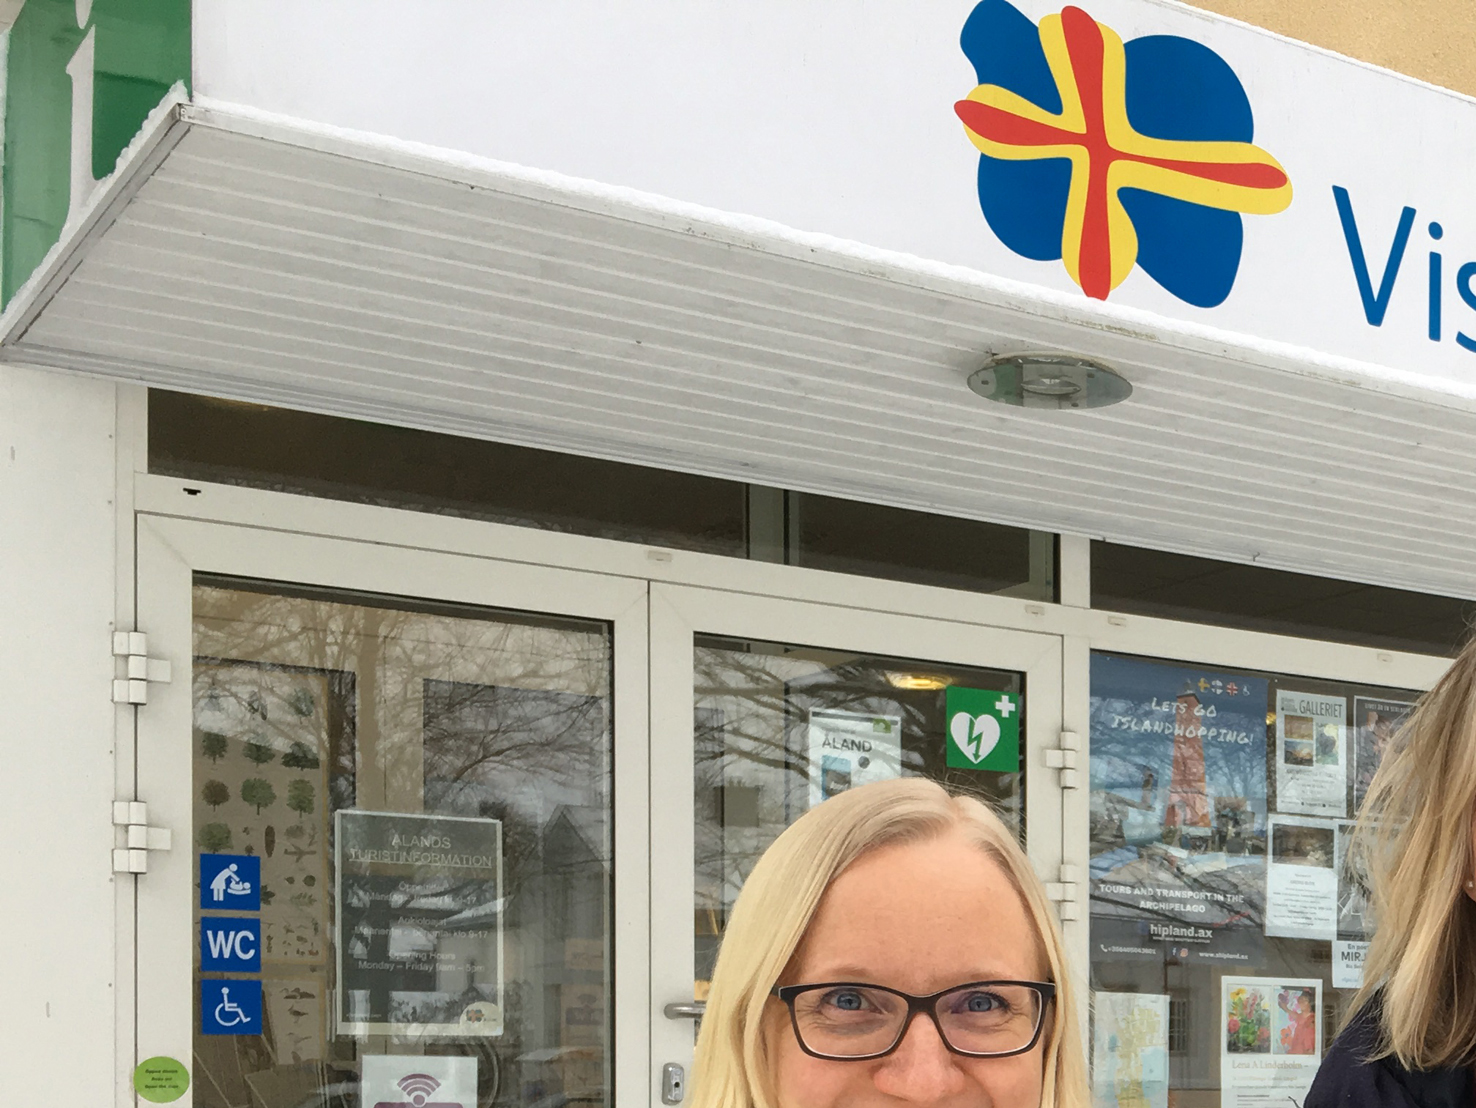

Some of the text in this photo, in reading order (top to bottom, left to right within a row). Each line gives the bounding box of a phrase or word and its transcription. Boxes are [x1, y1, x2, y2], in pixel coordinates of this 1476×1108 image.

[1152, 697, 1217, 718] LETS GO
[1299, 700, 1343, 719] GALLERIET
[1111, 714, 1254, 746] ISLANDHOPPING!
[821, 733, 873, 753] ÅLAND
[350, 849, 492, 868] TURISTINFORMATION
[1099, 884, 1132, 895] TOURS
[1133, 886, 1154, 896] AND
[1156, 888, 1212, 900] TRANSPORT
[1226, 893, 1245, 903] THE
[1139, 900, 1206, 914] ARCHIPELAGO
[1150, 924, 1213, 940] hipland.ax
[206, 930, 256, 960] WC
[358, 960, 396, 972] Monday
[405, 961, 433, 972] Friday
[1232, 1060, 1250, 1069] Lena
[1252, 1060, 1258, 1069] A
